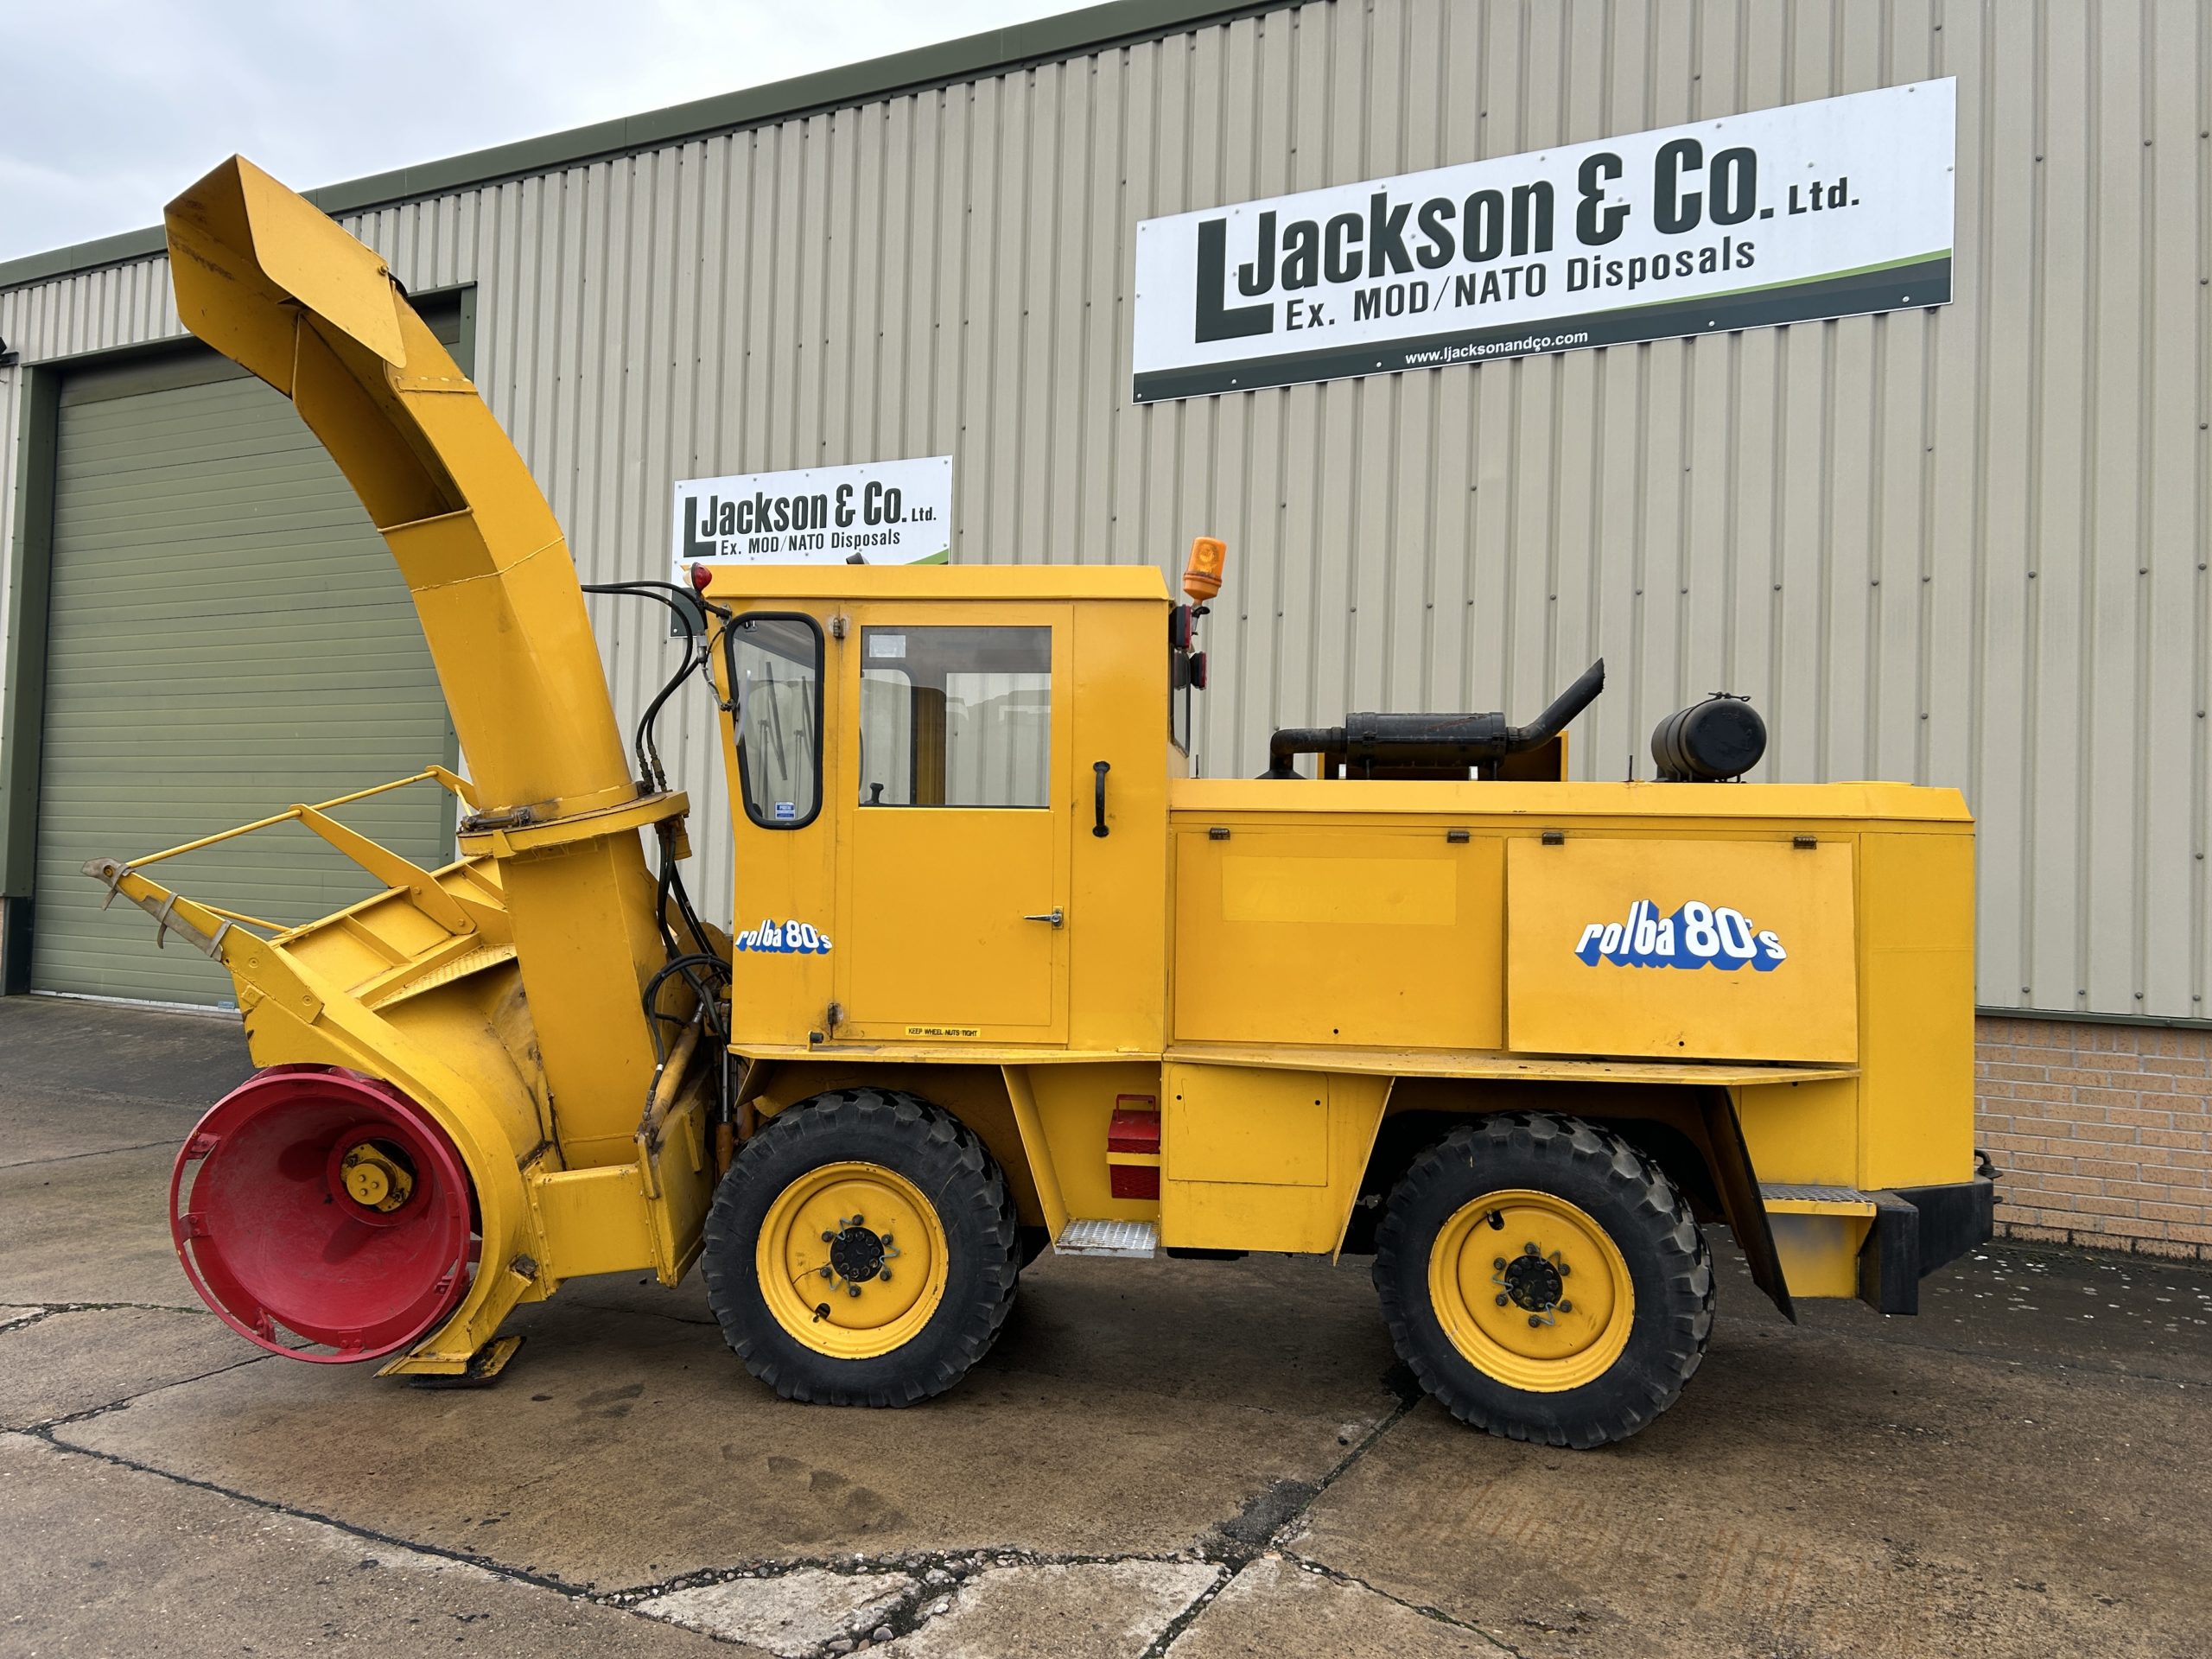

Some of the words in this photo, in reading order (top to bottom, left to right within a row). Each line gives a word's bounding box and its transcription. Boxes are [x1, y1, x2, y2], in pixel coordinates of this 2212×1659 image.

[1576, 153, 1630, 245] &
[1654, 139, 1774, 234] Co.
[1789, 177, 1859, 215] Ltd.
[1287, 299, 1335, 331] Ex.
[1354, 264, 1546, 321] MOD/NATO
[1567, 236, 1754, 292] Disposals
[1405, 332, 1588, 365] www.ljacksonandco.com
[836, 484, 855, 527] &
[864, 481, 906, 525] Co.
[912, 507, 937, 522] Ltd.
[721, 540, 741, 556] Ex.
[749, 533, 824, 554] MOD/NATO
[832, 529, 900, 550] Disposals
[735, 918, 783, 952] rolba
[1574, 899, 1675, 967] rolba
